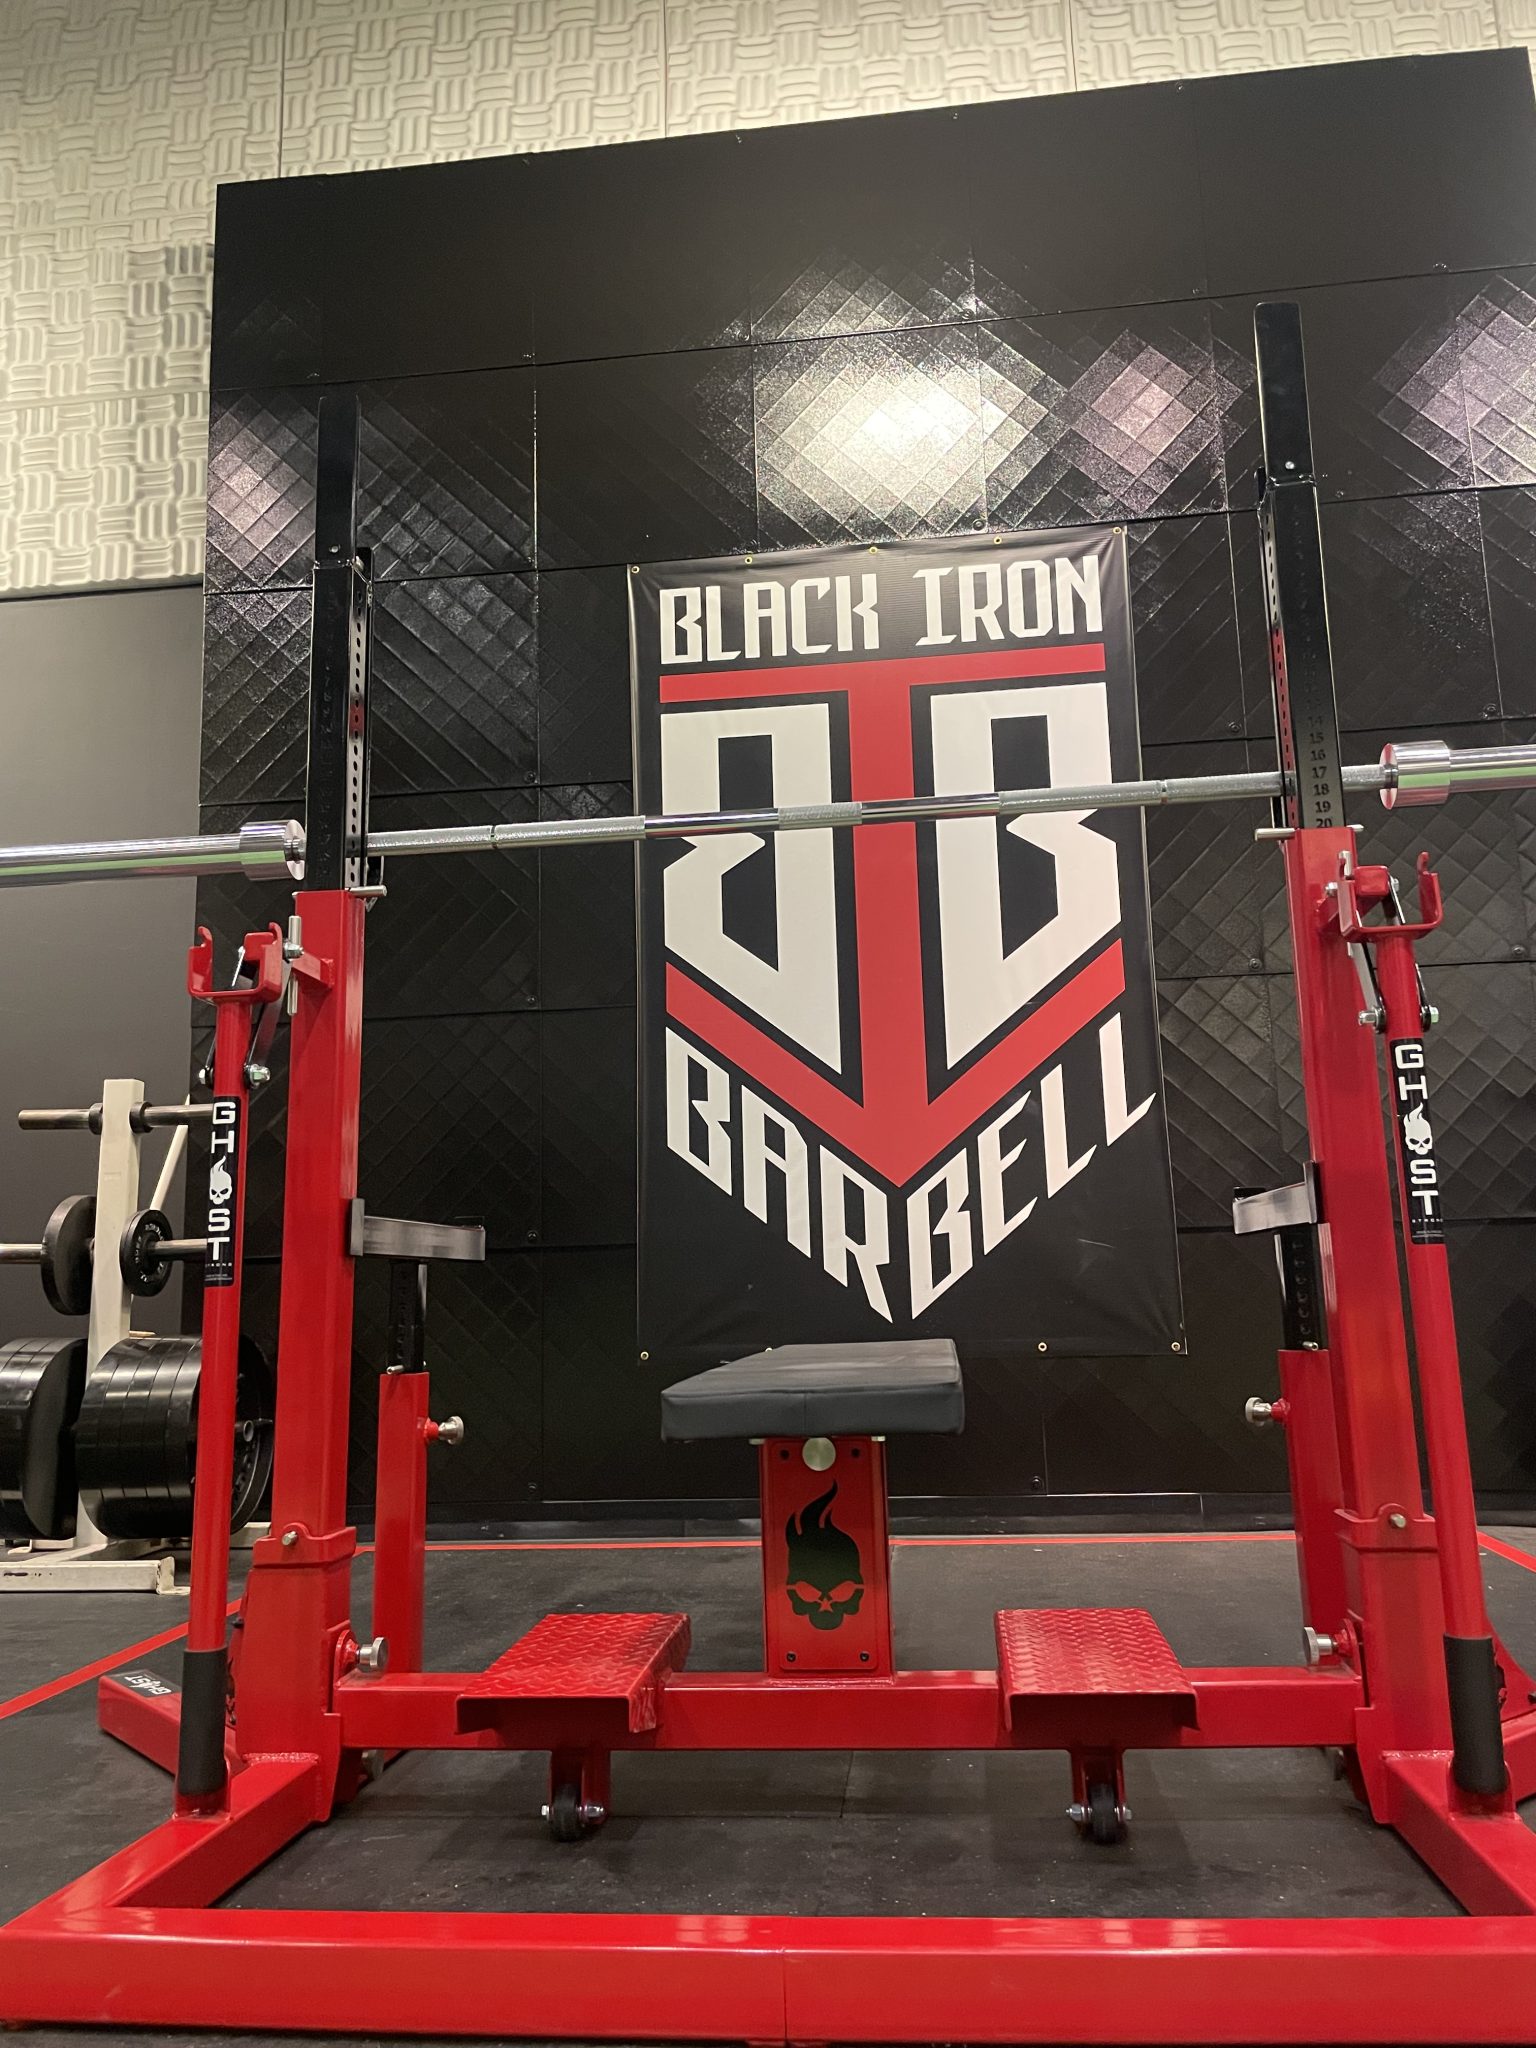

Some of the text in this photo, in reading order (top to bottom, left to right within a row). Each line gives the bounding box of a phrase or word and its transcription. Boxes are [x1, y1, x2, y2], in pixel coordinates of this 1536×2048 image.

[660, 555, 1104, 666] BLACK IRON
[1309, 732, 1324, 744] 15
[1310, 749, 1326, 761] 16
[1312, 766, 1328, 779] 17
[1313, 783, 1330, 796] 18
[1315, 800, 1331, 814] 19
[1316, 818, 1332, 828] 20
[665, 1011, 1157, 1324] BARBELL
